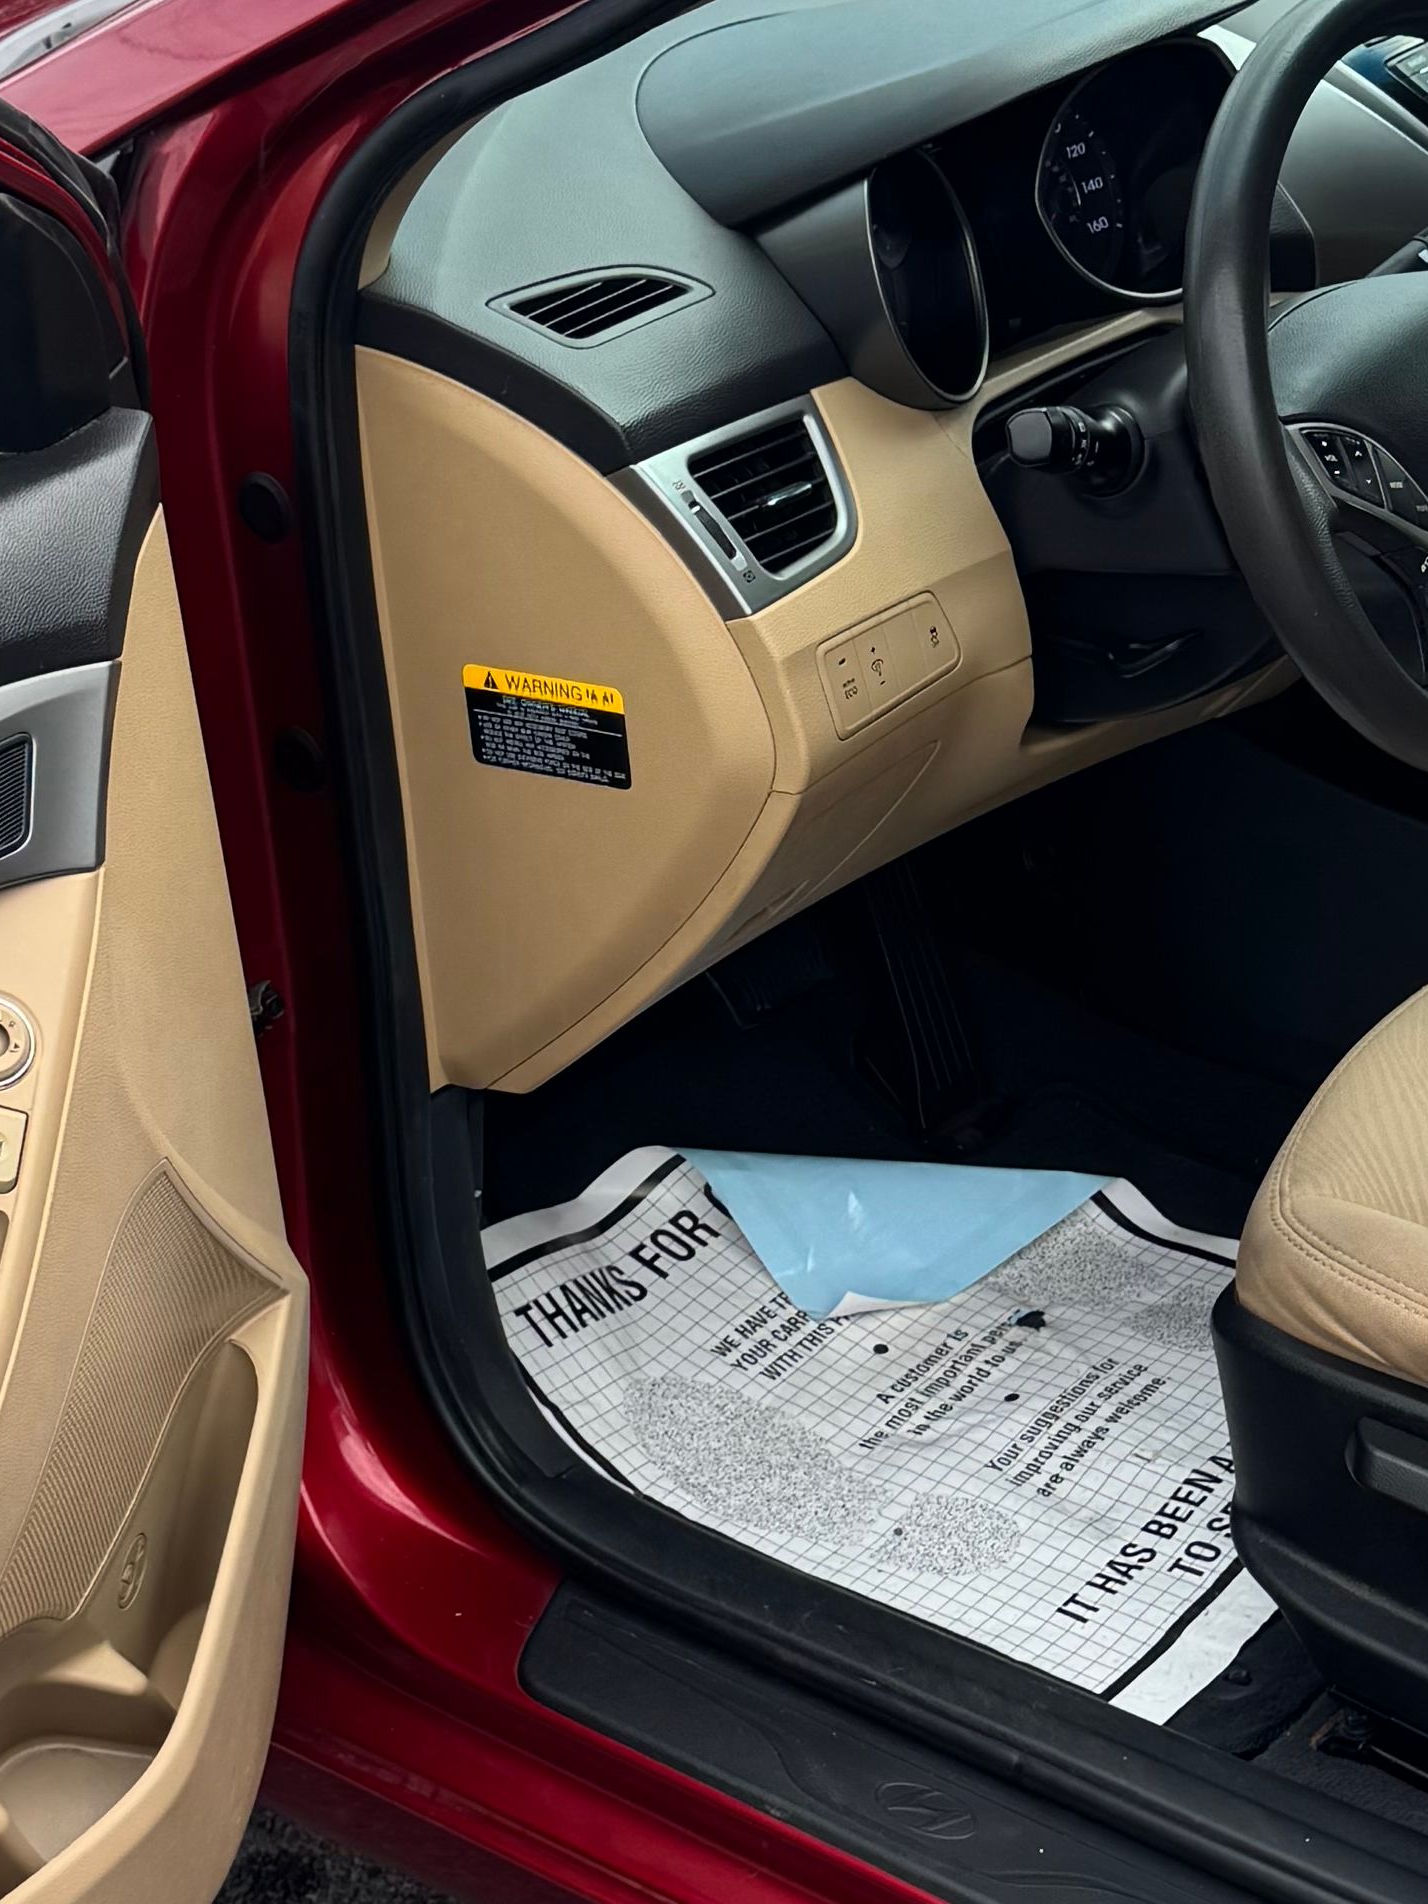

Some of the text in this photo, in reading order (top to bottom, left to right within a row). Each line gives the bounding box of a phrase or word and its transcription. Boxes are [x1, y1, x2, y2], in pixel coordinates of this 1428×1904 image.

[1066, 142, 1087, 159] 120
[1081, 176, 1104, 194] 140
[1087, 216, 1109, 234] 160
[504, 673, 583, 702] WARNING
[514, 1209, 722, 1347] THANKS FOR
[710, 1306, 778, 1357] WE HAVE
[730, 1339, 778, 1372] YOUR
[759, 1323, 835, 1381] WITH THIS
[859, 1427, 890, 1450] the
[885, 1395, 925, 1432] most
[920, 1342, 987, 1400] important
[876, 1329, 969, 1406] A customer is
[907, 1418, 931, 1437] in
[929, 1400, 954, 1422] the
[950, 1367, 991, 1405] world
[985, 1351, 1006, 1369] to
[984, 1356, 1121, 1474] Your suggestions for
[1005, 1361, 1149, 1489] improving our service
[1036, 1373, 1172, 1499] are always welcome.
[1056, 1593, 1100, 1624] IT
[1086, 1542, 1157, 1595] HAS
[1141, 1469, 1223, 1540] BEEN
[1167, 1540, 1222, 1577] TO
